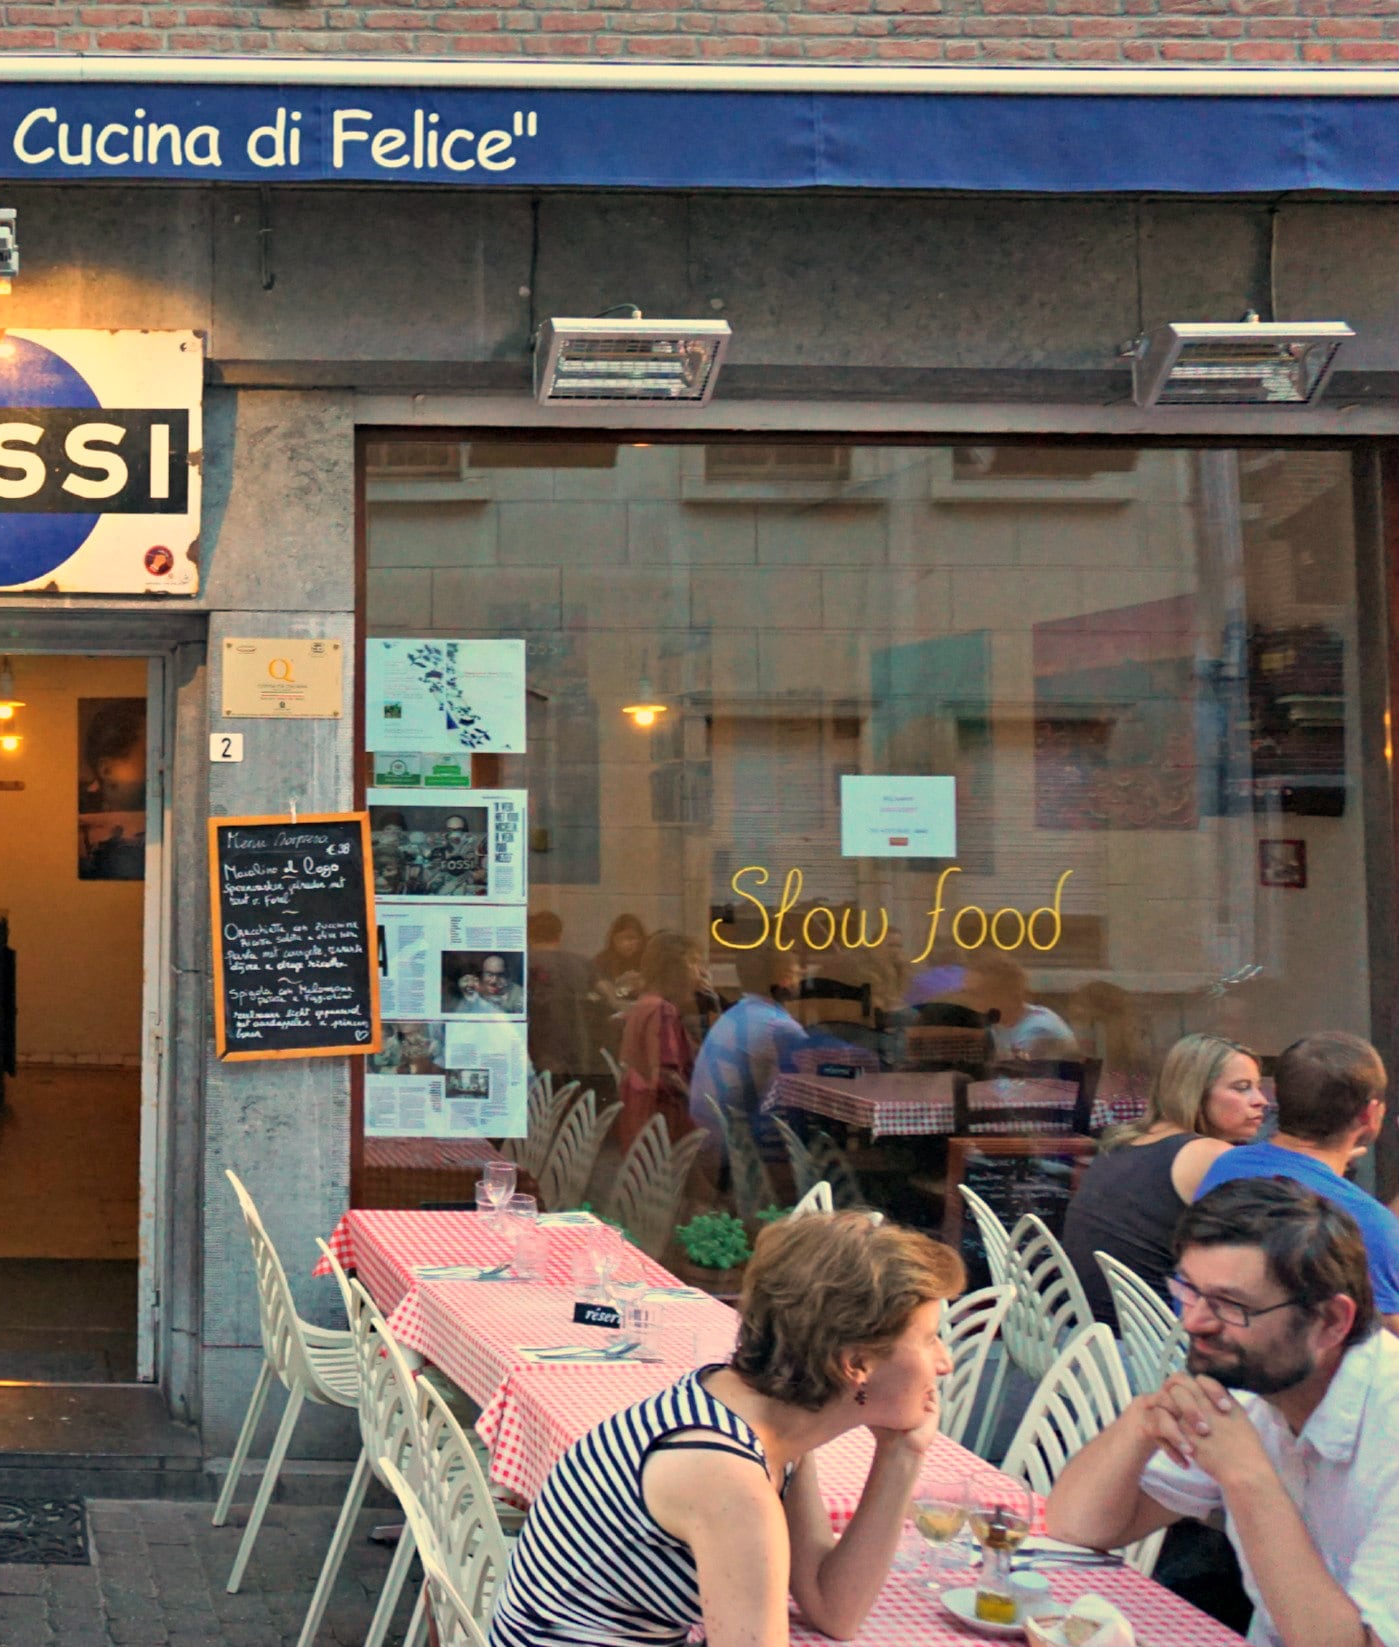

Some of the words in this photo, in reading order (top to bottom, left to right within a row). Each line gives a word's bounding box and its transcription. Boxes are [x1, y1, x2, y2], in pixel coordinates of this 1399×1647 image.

[12, 106, 223, 167] Cucina
[246, 106, 302, 167] di
[332, 109, 538, 171] Felice"
[267, 657, 297, 683] Q
[221, 737, 233, 758] 2
[711, 865, 889, 951] Slow
[911, 866, 1074, 964] food
